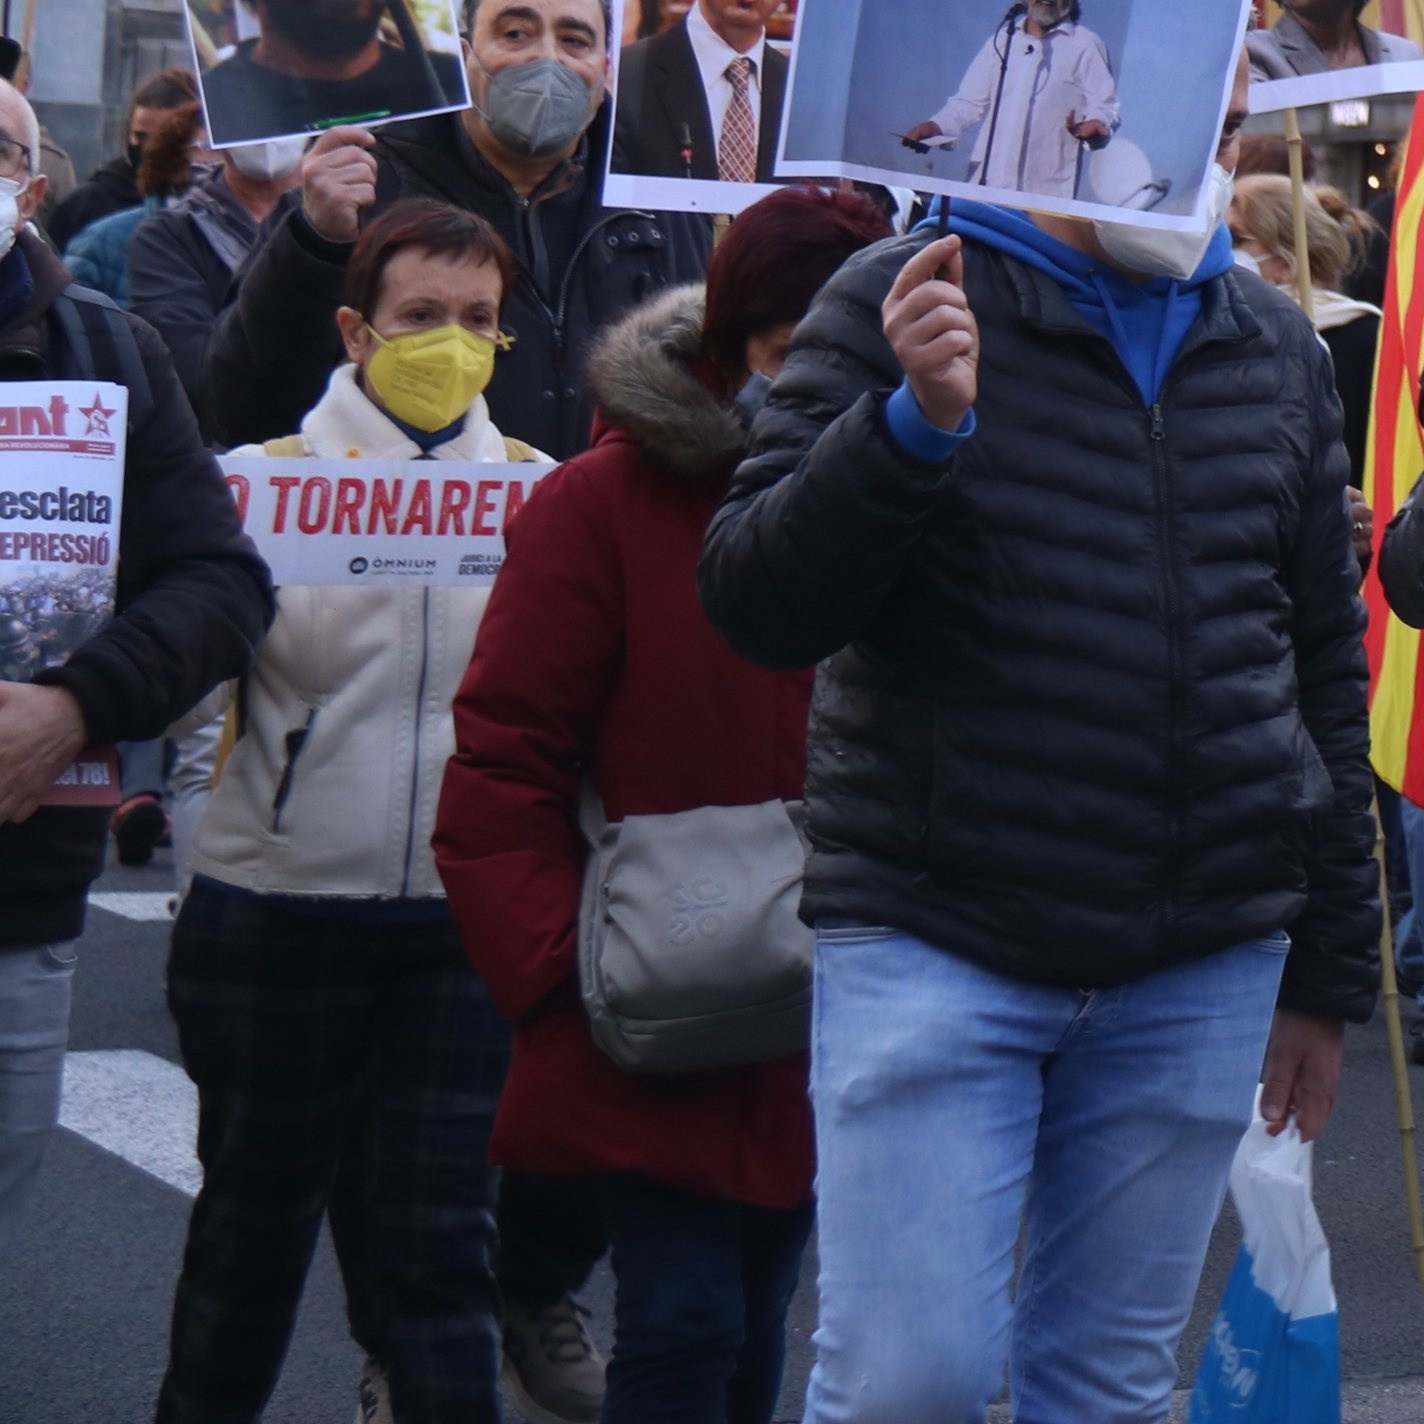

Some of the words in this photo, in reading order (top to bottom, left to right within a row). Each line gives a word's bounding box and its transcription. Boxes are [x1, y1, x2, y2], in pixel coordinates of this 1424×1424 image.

[0, 395, 69, 435] ant
[0, 486, 112, 524] esclata
[225, 474, 250, 526] O
[0, 531, 110, 566] EPRESSIÓ
[457, 563, 500, 576] DEMOCR
